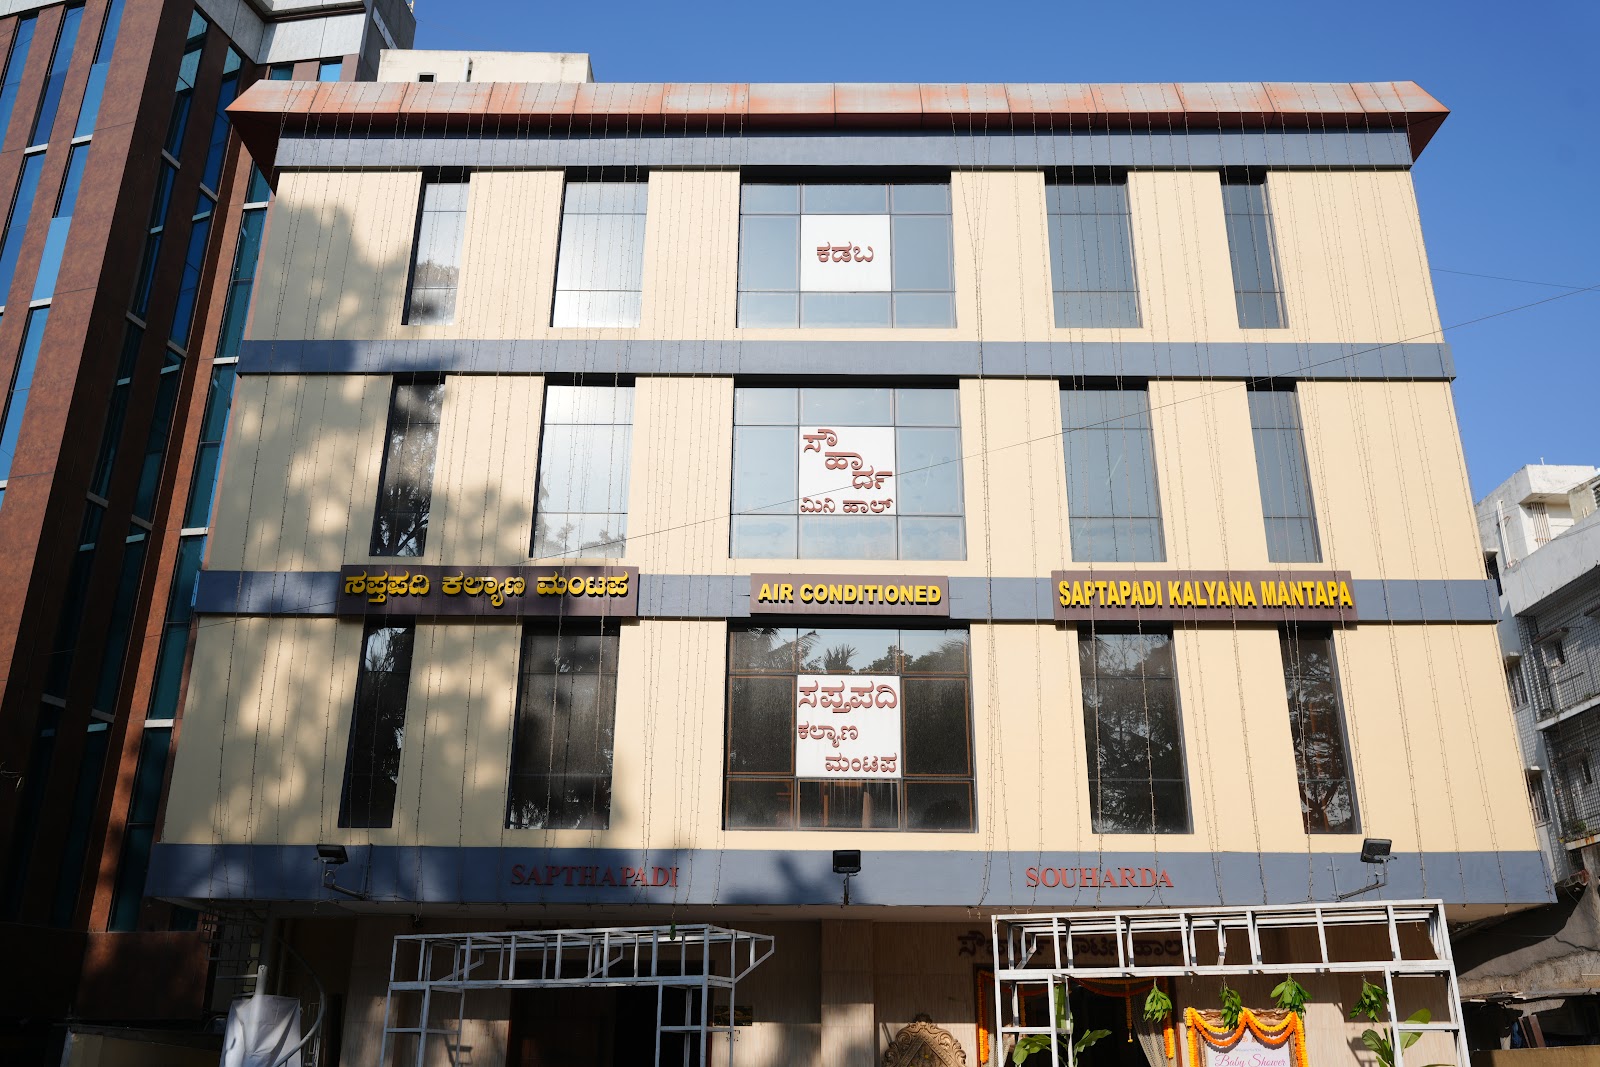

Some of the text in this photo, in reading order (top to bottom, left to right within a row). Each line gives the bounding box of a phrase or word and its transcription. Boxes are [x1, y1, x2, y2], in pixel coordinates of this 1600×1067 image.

[816, 241, 874, 263] ಕಡಬ
[800, 497, 894, 514] ಮಿನಿ ಹಾಲ್
[344, 570, 629, 606] ಸಪ್ತಪದಿ ಕಲ್ಯಾಣ ಮಂಟಪ
[758, 583, 942, 603] AIR CONDITIONED
[1058, 580, 1354, 607] SAPTAPADI KALYANA MANTAPA
[798, 680, 898, 714] ಸಪ್ತಪದಿ
[797, 720, 859, 748] ಕಲ್ಯಾಣ
[825, 753, 898, 773] ಮಂಟಪ
[511, 863, 680, 887] SAPTHAPADI
[1025, 867, 1175, 888] SOUHARDA
[1214, 1053, 1287, 1067] Baby Shower
